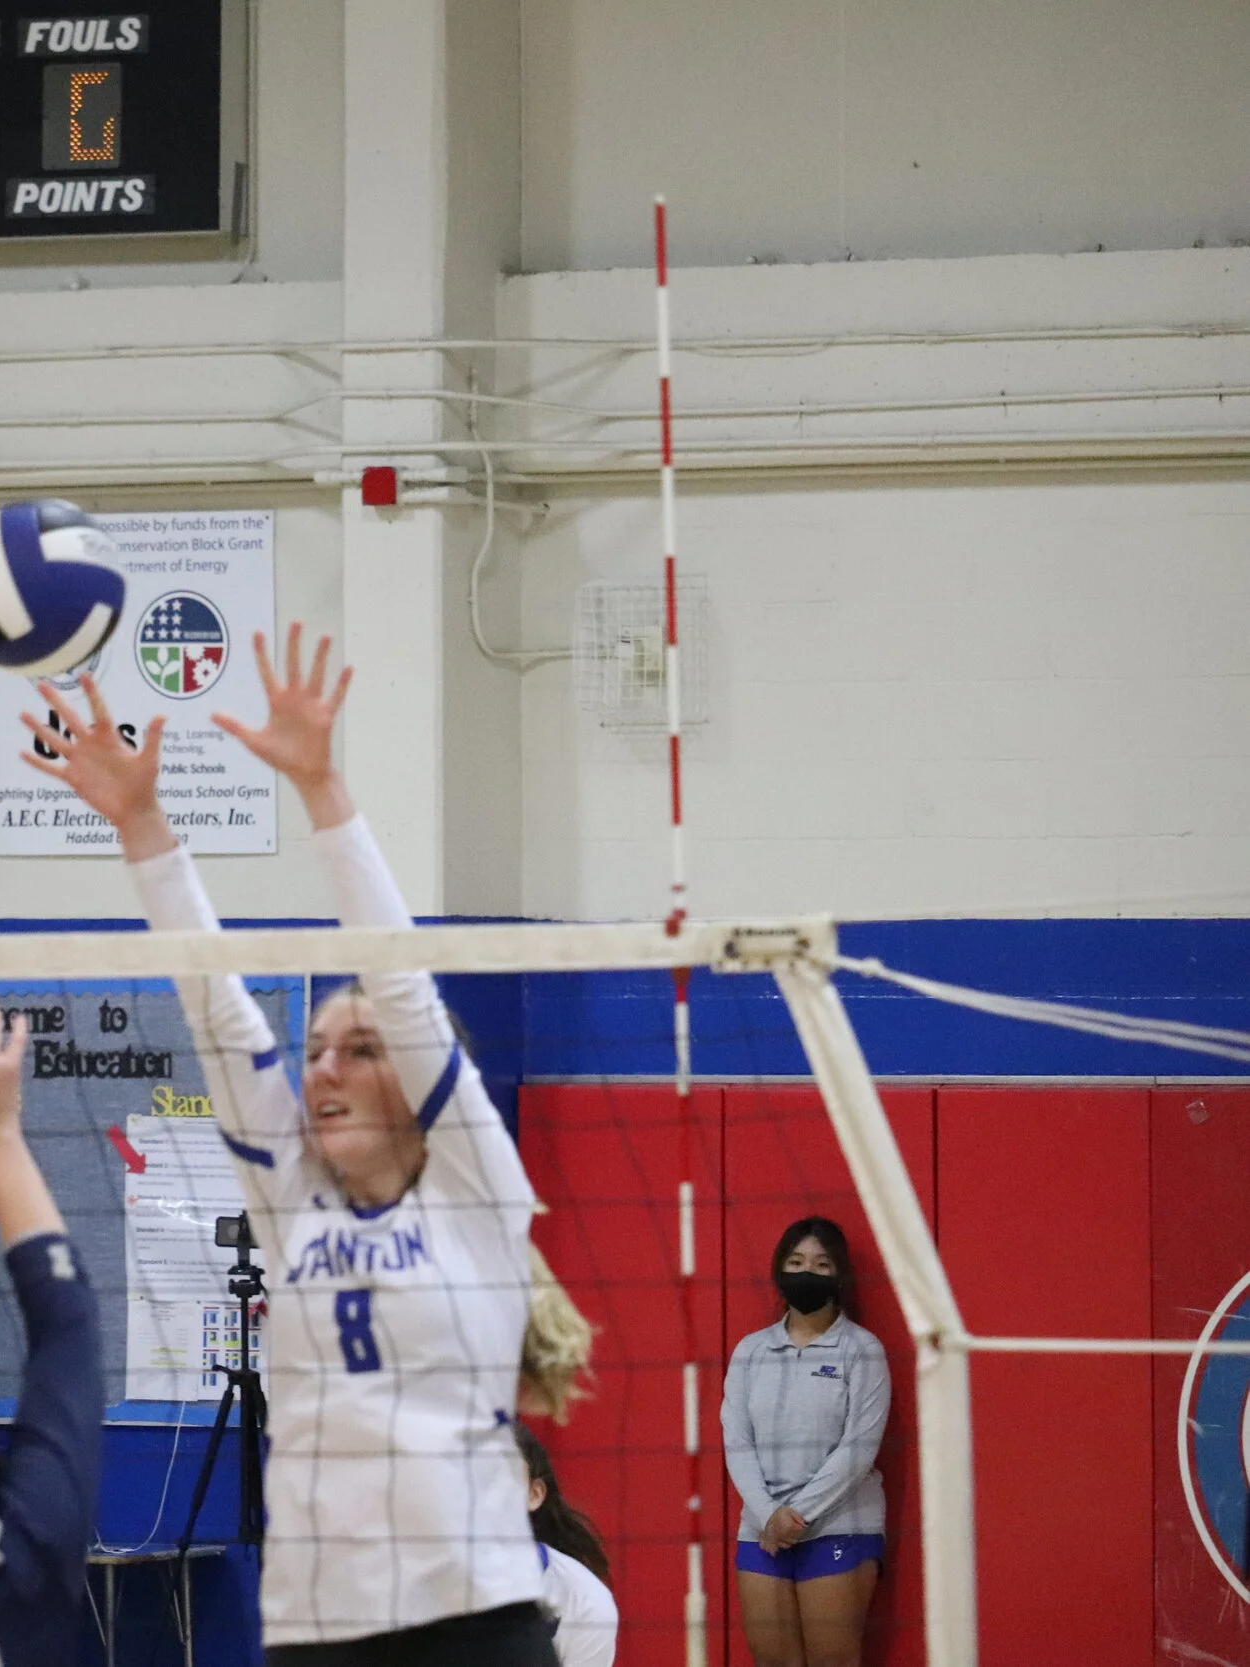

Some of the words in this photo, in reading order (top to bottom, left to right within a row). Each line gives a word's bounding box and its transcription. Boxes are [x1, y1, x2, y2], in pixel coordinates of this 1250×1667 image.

[25, 18, 141, 54] FOULS
[14, 179, 146, 214] POINTS
[153, 519, 168, 533] by
[171, 517, 206, 531] funds
[210, 517, 239, 530] from
[243, 517, 264, 529] the
[192, 539, 224, 552] Block
[228, 538, 264, 550] Grant
[170, 559, 181, 572] of
[186, 558, 228, 574] Energy
[190, 762, 226, 775] Schools
[196, 784, 235, 799] School
[237, 785, 270, 800] Gyms
[1, 810, 48, 828] A.E.C.
[227, 807, 256, 826] Inc.
[65, 831, 114, 844] Haddad
[99, 1000, 128, 1034] to
[32, 1039, 172, 1079] Education
[334, 1287, 382, 1373] 8
